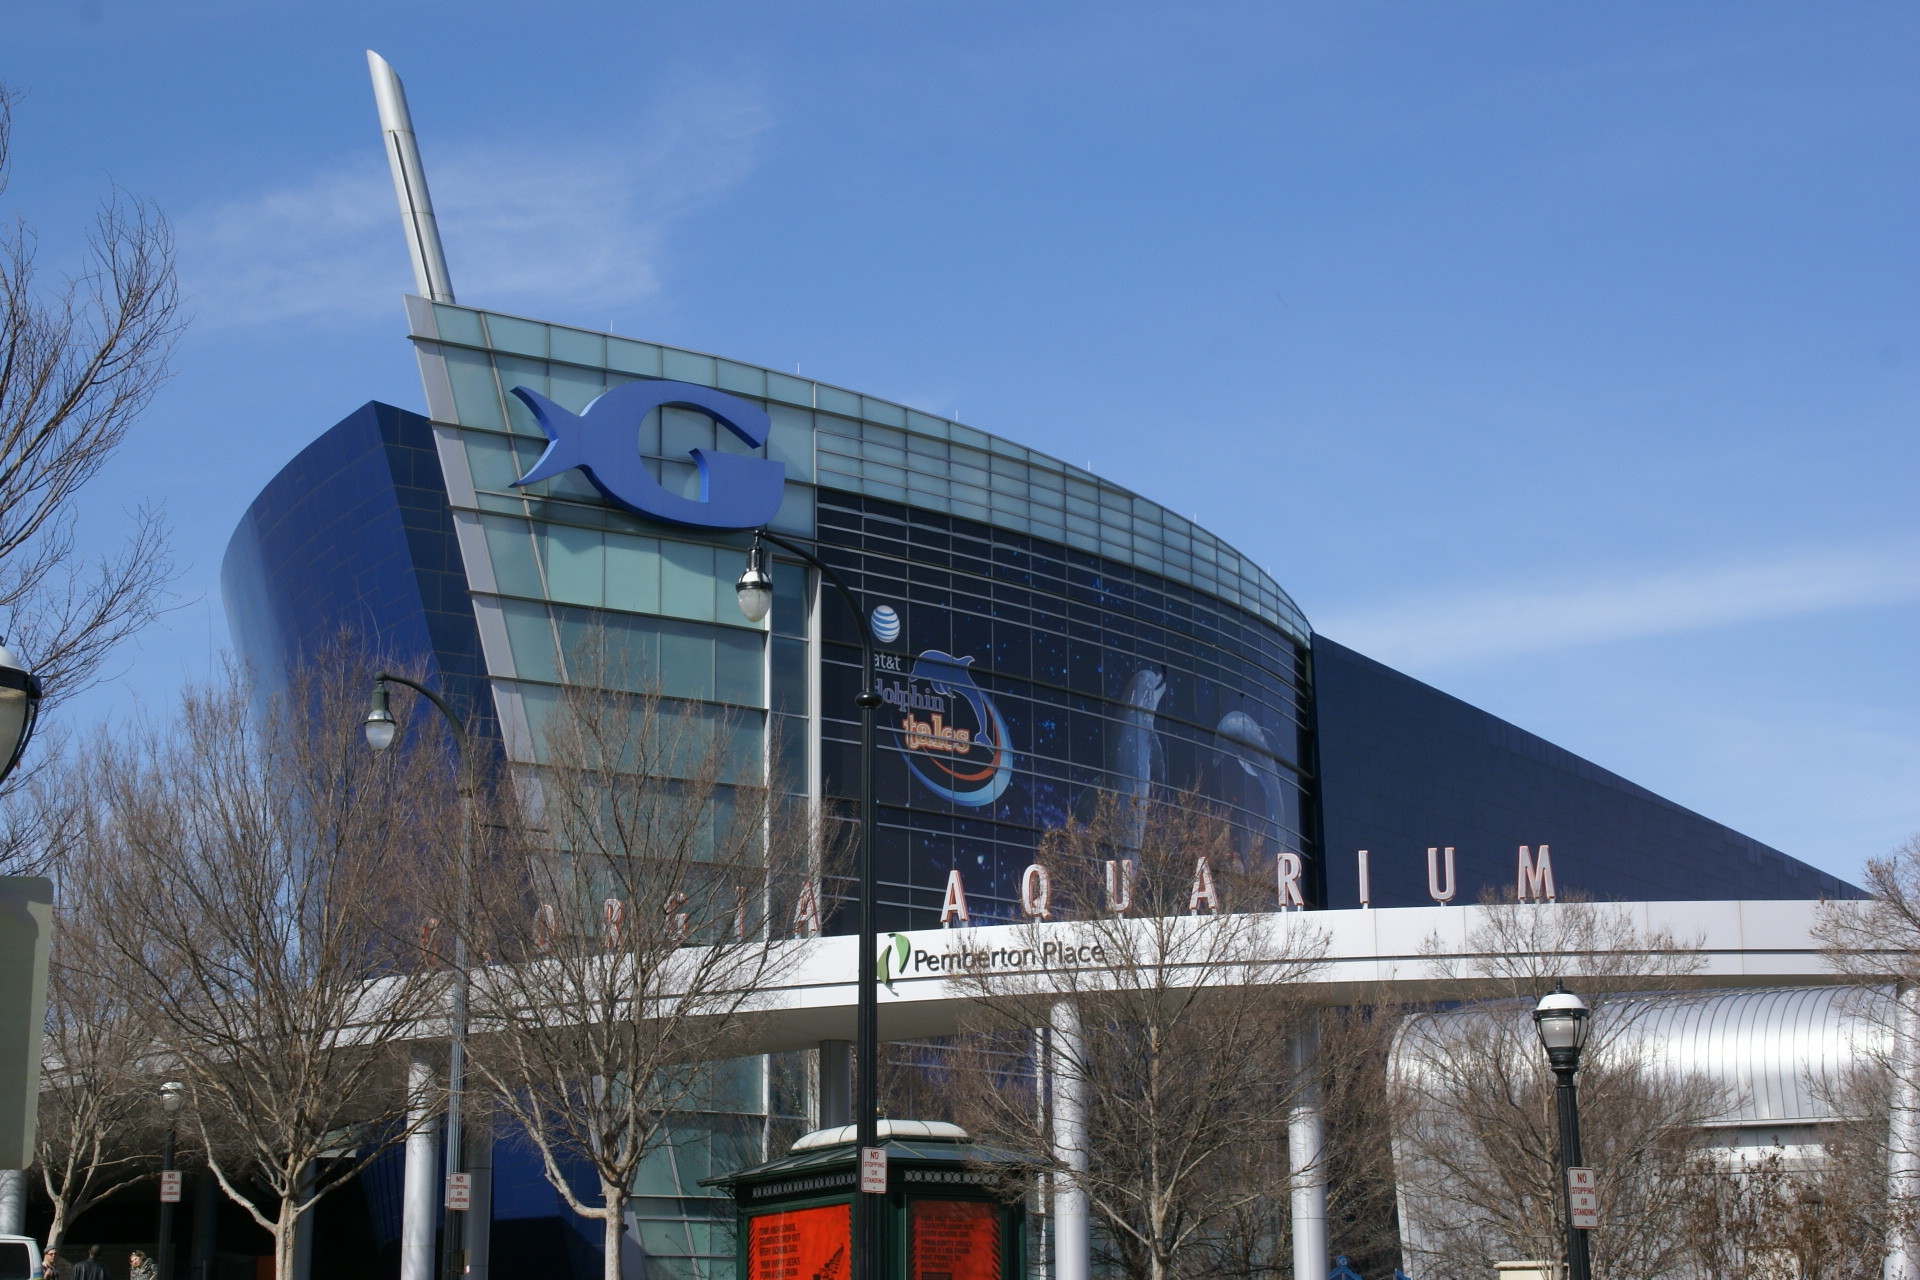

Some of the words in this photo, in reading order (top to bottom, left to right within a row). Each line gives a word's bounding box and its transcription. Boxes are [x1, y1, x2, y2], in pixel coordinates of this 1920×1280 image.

[874, 653, 901, 671] at&t
[902, 713, 970, 754] tales
[940, 845, 1555, 923] AQUARIUM
[914, 945, 1035, 972] Pemberton
[1043, 941, 1105, 966] Place
[870, 1151, 879, 1160] NO
[1577, 1173, 1587, 1183] NO
[1572, 1187, 1594, 1195] STOPPING
[1574, 1208, 1596, 1216] STANDING
[759, 1236, 779, 1246] STUDENTS
[792, 1233, 800, 1242] OUT
[786, 1257, 800, 1266] DESKS
